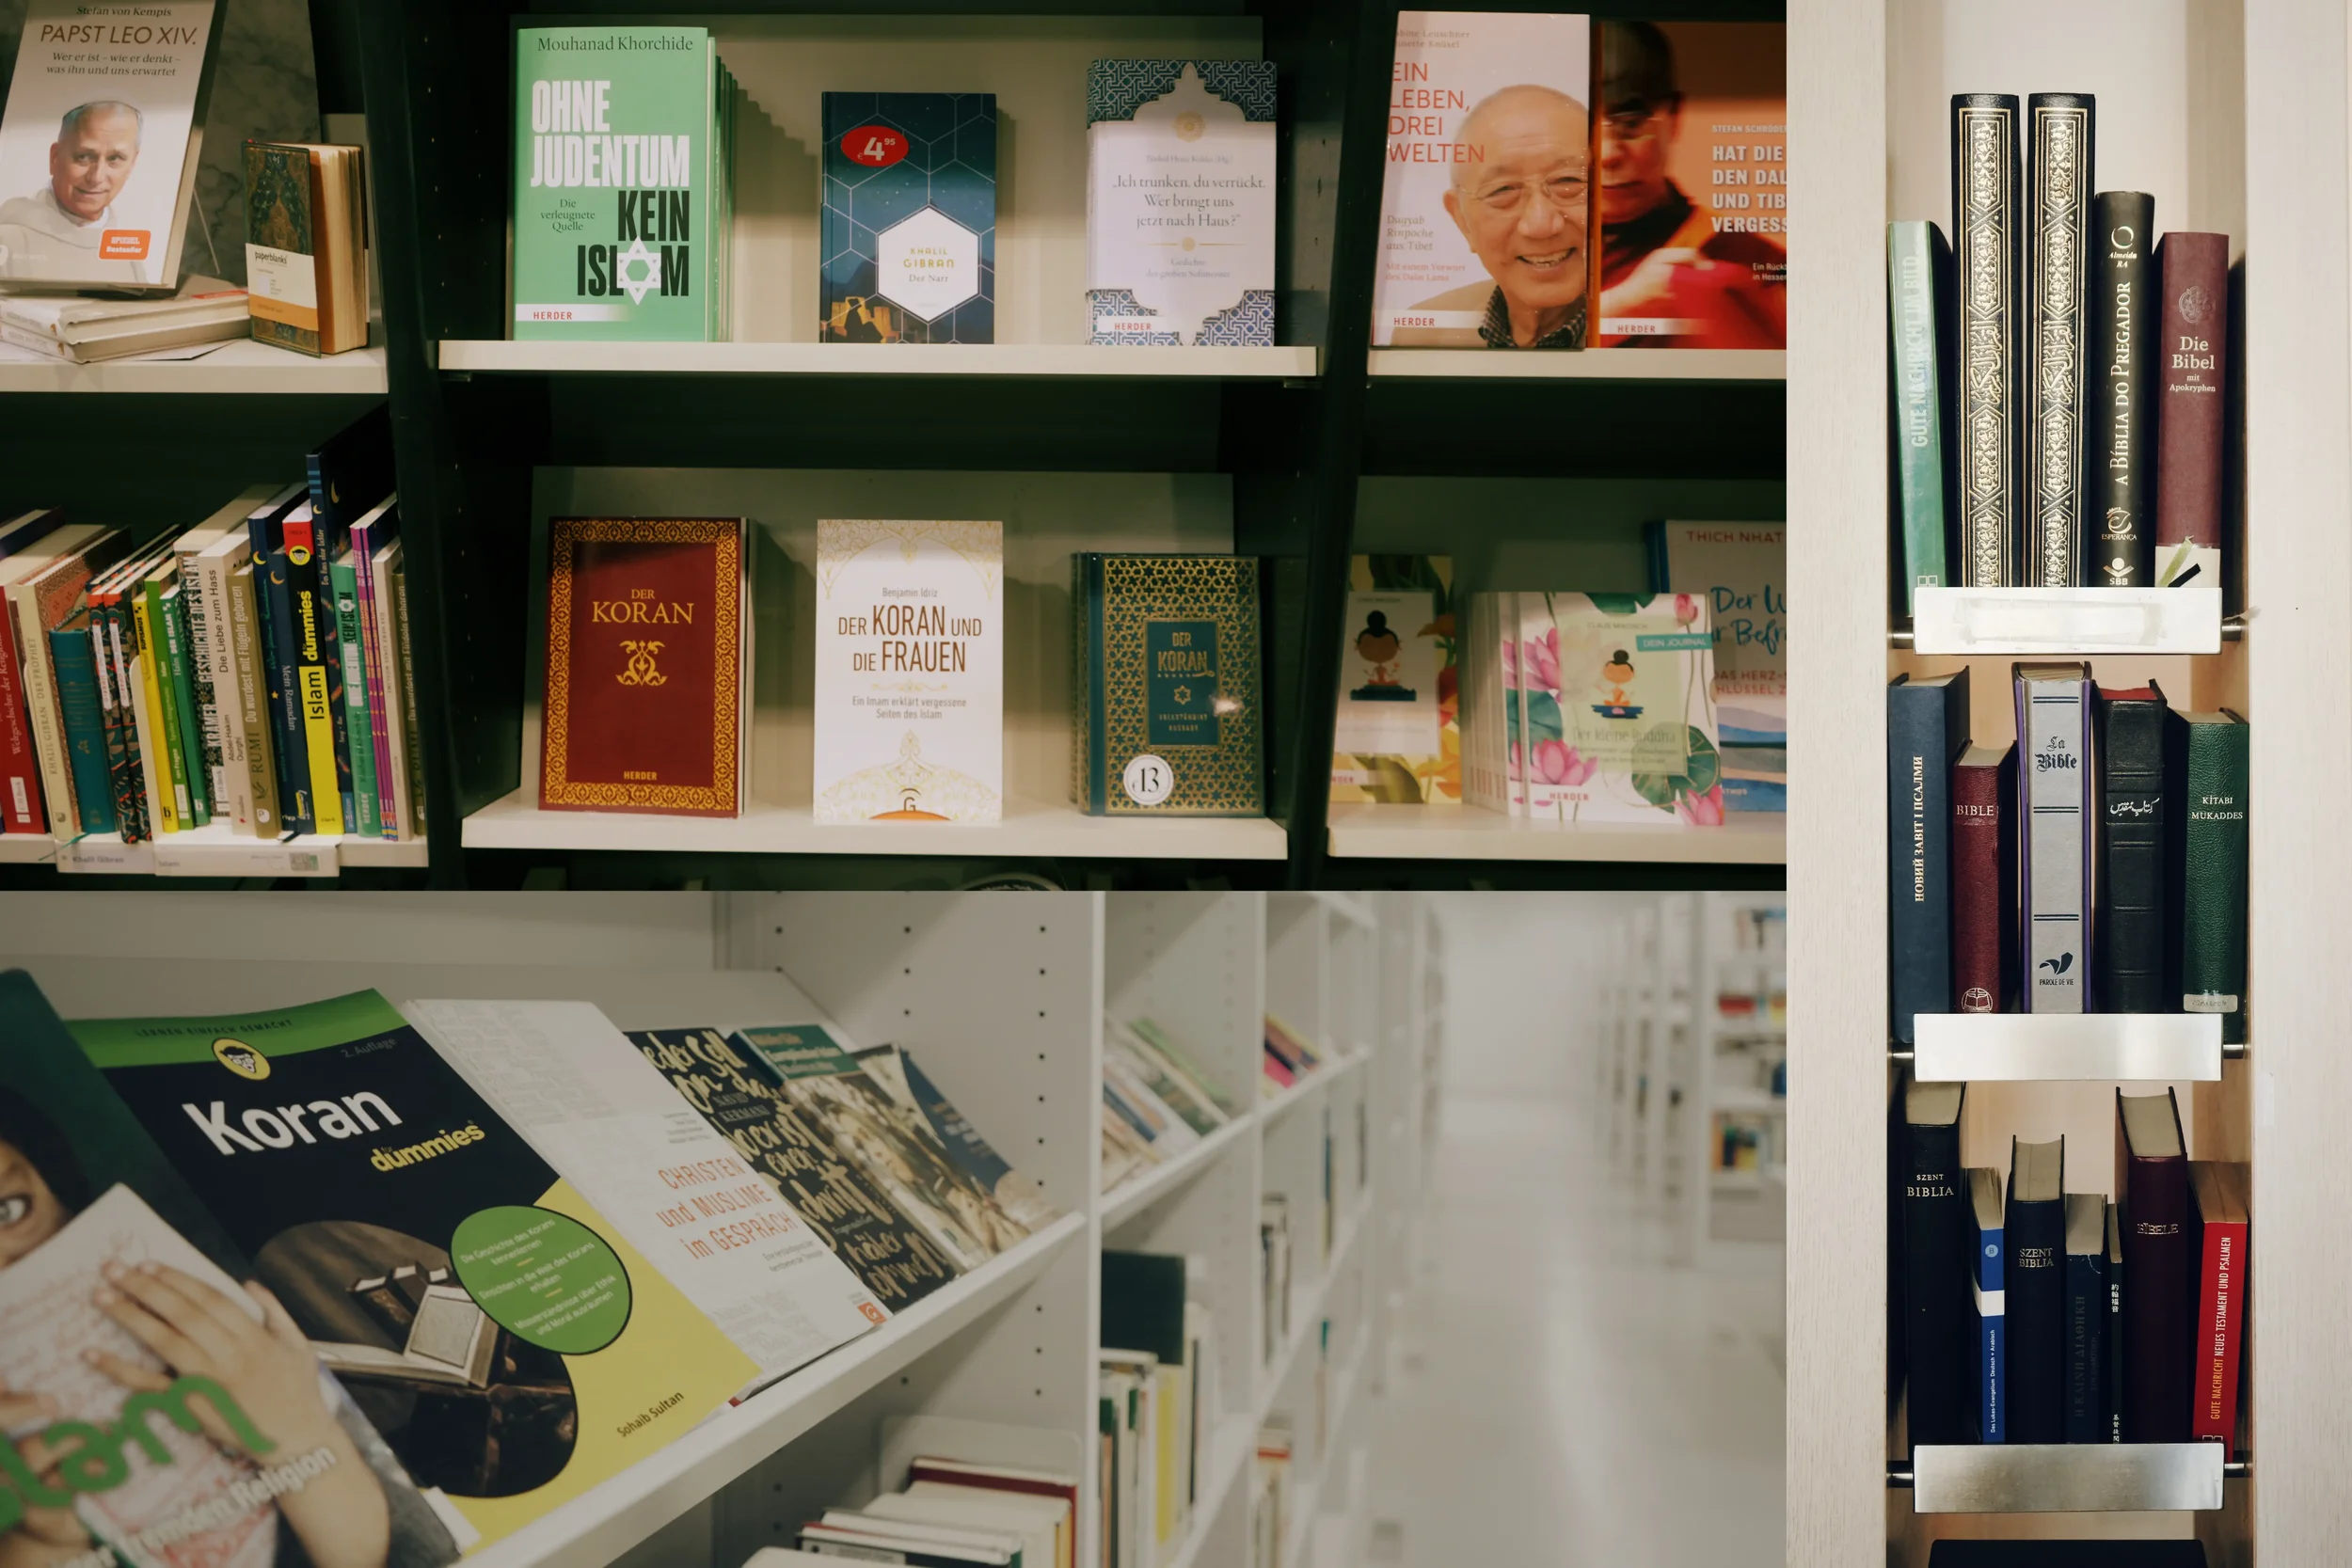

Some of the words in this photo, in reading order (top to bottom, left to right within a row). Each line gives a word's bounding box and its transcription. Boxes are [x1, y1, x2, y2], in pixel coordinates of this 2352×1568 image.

[77, 7, 108, 15] Stefan
[133, 8, 171, 17] Kempis
[40, 24, 104, 43] PAPST
[109, 26, 152, 43] LEO
[156, 27, 197, 45] XIV.
[538, 36, 613, 52] Mouhanad
[617, 35, 693, 51] Khorchide
[53, 52, 72, 61] Wer
[87, 53, 100, 61] ist
[110, 54, 127, 62] wie
[142, 54, 172, 63] denkt
[68, 65, 85, 74] ihn
[87, 66, 108, 74] und
[132, 67, 176, 76] erwartet
[532, 81, 611, 133] OHNE
[1390, 116, 1442, 135] DREI
[531, 135, 690, 187] JUDENTUM
[1390, 143, 1485, 163] WELTEN
[1713, 146, 1746, 161] HAT
[1755, 147, 1783, 161] DIE
[1713, 170, 1747, 184] DEN
[560, 198, 577, 208] Die
[1144, 194, 1170, 207] Wer
[1172, 194, 1210, 212] bringt
[1214, 198, 1234, 207] uns
[1713, 194, 1749, 209] UND
[540, 211, 596, 221] verleugnete
[618, 191, 690, 242] KEIN
[1388, 215, 1424, 226] Dagyab
[552, 222, 583, 233] Quelle
[1408, 242, 1433, 250] Tibet
[254, 250, 287, 264] paperblanks
[903, 259, 954, 268] GIBRAN
[909, 274, 930, 282] Der
[931, 274, 948, 282] Narr
[533, 311, 573, 320] HERDER
[1394, 318, 1435, 326] HERDER
[2111, 282, 2131, 376] PREGADOR
[2180, 337, 2209, 351] Die
[1906, 321, 1927, 404] NACHRICHT
[2172, 354, 2216, 370] Bibel
[2115, 382, 2129, 406] DO
[2169, 384, 2216, 392] Apokryphen
[1911, 407, 1929, 447] GUTE
[2109, 411, 2129, 468] BÍBLIA
[1686, 531, 1735, 543] THICH
[1739, 531, 1783, 543] NHAT
[2102, 533, 2137, 542] ESPERANÇA
[209, 569, 218, 596] Hass
[630, 589, 656, 599] DER
[882, 588, 918, 599] Benjamin
[921, 588, 938, 597] Idriz
[232, 586, 248, 623] geboren
[592, 602, 694, 625] KORAN
[838, 617, 866, 635] DER
[873, 605, 945, 636] KORAN
[951, 618, 981, 636] UND
[299, 591, 318, 661] dummies
[215, 625, 226, 653] Liebe
[235, 624, 251, 655] Flügeln
[1172, 632, 1191, 646] DER
[1643, 639, 1665, 648] DEIN
[1666, 638, 1707, 647] JOURNAL
[219, 656, 229, 673] Die
[240, 656, 251, 673] mit
[853, 653, 876, 671] DIE
[882, 641, 965, 672] FRAUEN
[1158, 651, 1208, 672] KORAN
[242, 674, 256, 708] wurdest
[308, 672, 325, 720] Islam
[852, 696, 865, 705] Ein
[866, 697, 889, 705] Imam
[892, 696, 918, 705] erklärt
[921, 698, 966, 708] vergessene
[246, 711, 257, 723] Du
[876, 709, 901, 719] Seiten
[904, 709, 917, 719] des
[920, 709, 942, 719] Islam
[225, 715, 234, 761] Abdel-Hakim
[2046, 736, 2065, 752] La
[247, 733, 264, 773] RUMI
[2034, 752, 2077, 772] Bible
[624, 770, 658, 781] HERDER
[1913, 755, 1923, 810] ПСАЛМИ
[1549, 792, 1589, 801] HERDER
[1957, 804, 1994, 816] BIBLE
[2191, 812, 2244, 820] MUKADDES
[1914, 821, 1924, 855] ЗАВІТ
[1913, 858, 1925, 902] НОВИЙ
[239, 1019, 294, 1034] GEMACHT
[355, 1037, 398, 1057] Auflage
[182, 1091, 403, 1156] Koran
[659, 1156, 746, 1190] CHRISTEN
[1907, 1186, 1955, 1197] BIBLIA
[656, 1201, 696, 1227] und
[691, 1183, 772, 1218] MUSLIME
[679, 1238, 715, 1260] im
[708, 1210, 799, 1251] GESPRÄCH
[2019, 1247, 2053, 1259] SZENT
[2219, 1237, 2232, 1270] PSALMEN
[2019, 1259, 2055, 1268] BIBLIA
[2218, 1273, 2230, 1290] UND
[2216, 1291, 2229, 1331] TESTAMENT
[2215, 1333, 2226, 1356] NEUES
[2212, 1358, 2224, 1400] NACHRICHT
[616, 1413, 652, 1438] Sohaib
[648, 1392, 685, 1418] Sultan
[2211, 1402, 2221, 1419] GUTE
